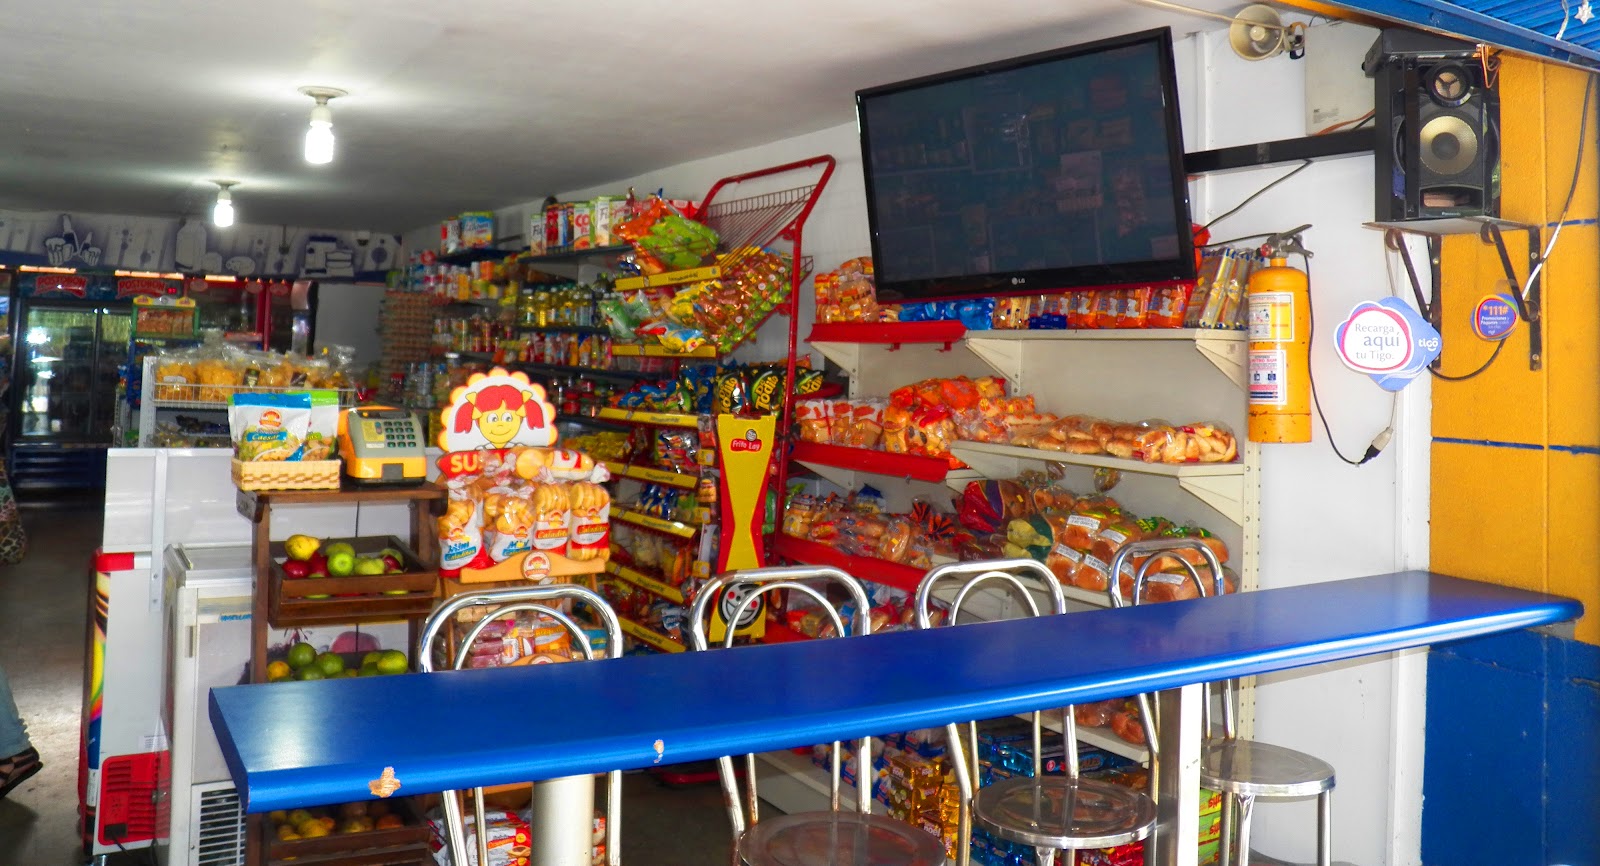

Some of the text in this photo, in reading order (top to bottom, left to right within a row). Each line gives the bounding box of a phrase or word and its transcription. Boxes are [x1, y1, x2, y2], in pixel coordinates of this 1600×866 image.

[1355, 323, 1394, 335] Recarga
[1363, 332, 1400, 351] aquí
[1356, 350, 1395, 361] tu Tigo.
[755, 375, 778, 410] Todito
[251, 433, 280, 442] Caesar
[732, 440, 760, 451] Frito Lay
